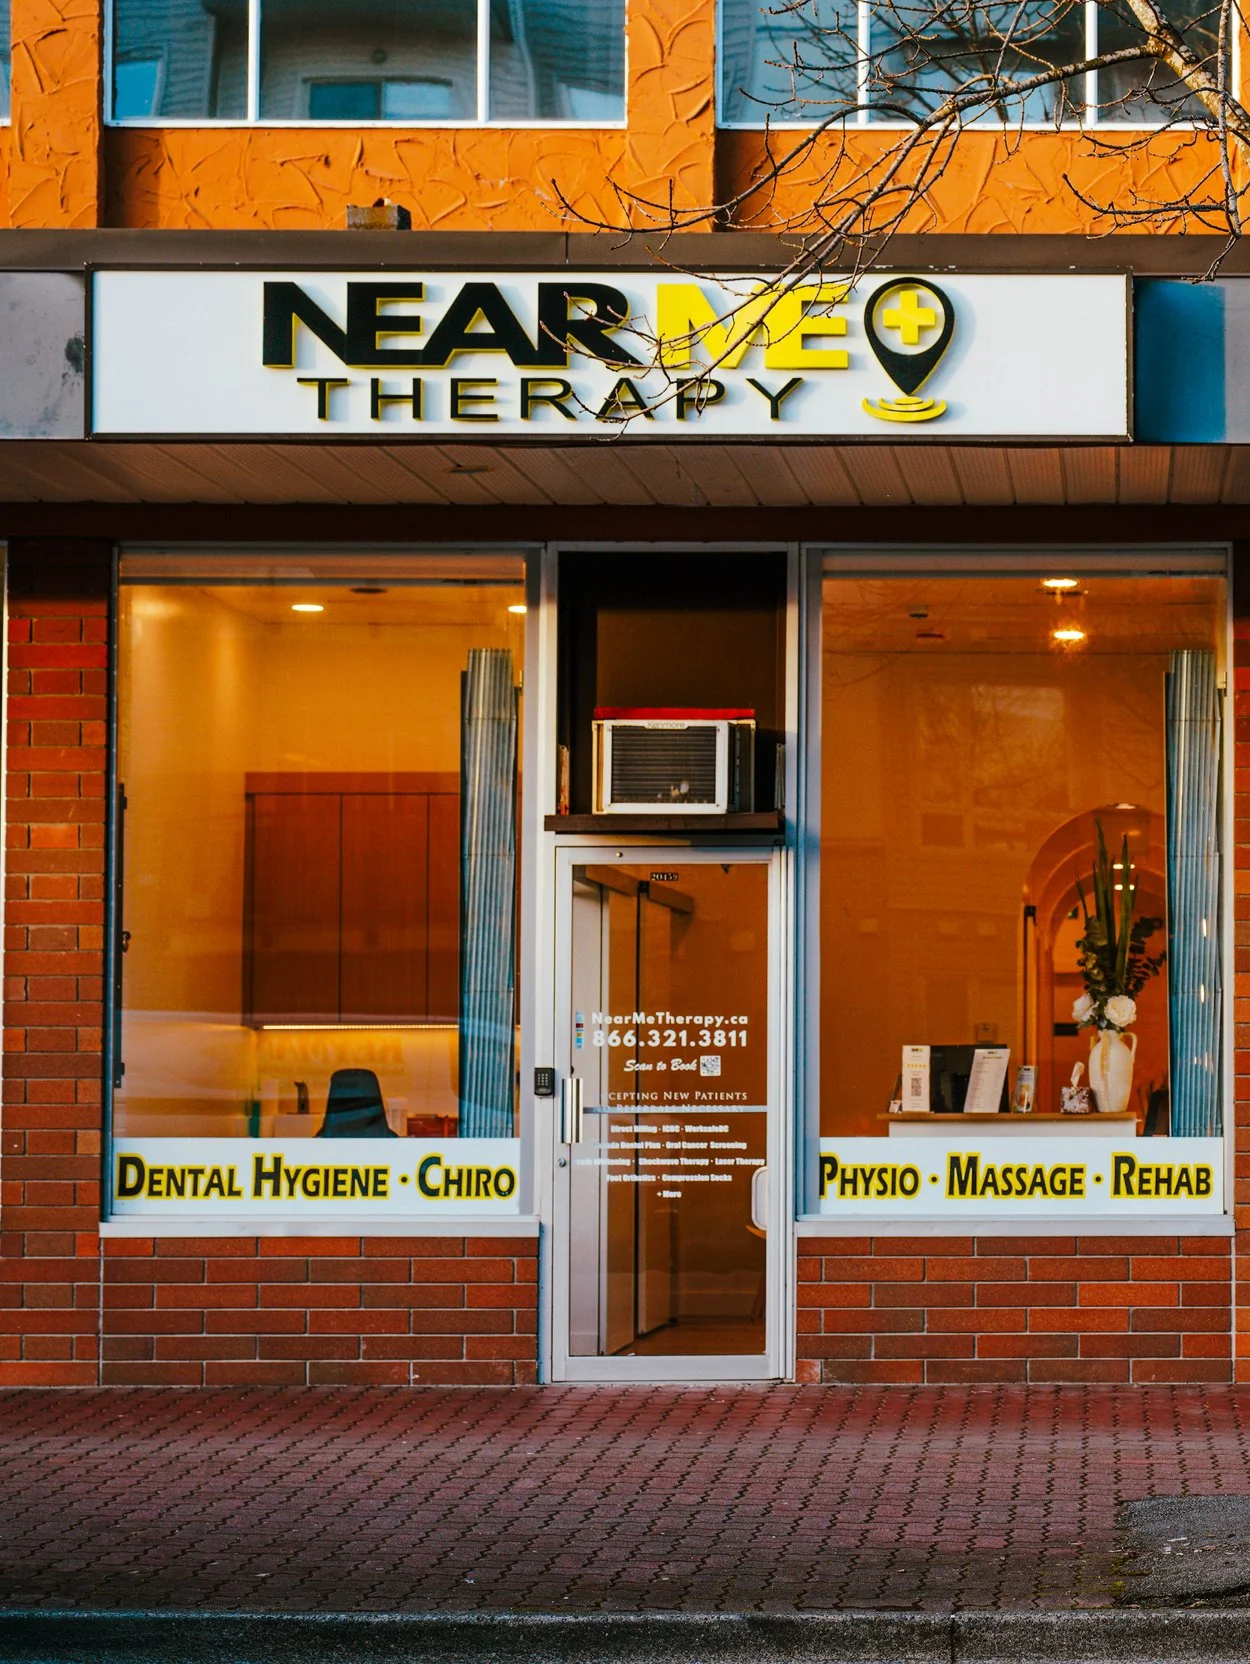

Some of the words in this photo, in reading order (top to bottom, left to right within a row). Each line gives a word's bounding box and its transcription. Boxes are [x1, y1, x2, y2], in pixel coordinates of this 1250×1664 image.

[296, 377, 802, 423] THERAPY
[591, 1012, 748, 1027] NearMeTherapy.ca
[592, 1030, 747, 1047] 866.321.3811
[624, 1059, 653, 1072] Scan
[656, 1061, 667, 1071] to
[671, 1058, 698, 1071] Book
[663, 1091, 690, 1100] NEW
[695, 1091, 748, 1100] PATIENTS
[116, 1155, 243, 1199] DENTAL
[252, 1155, 389, 1199] HYGIENE
[419, 1155, 515, 1199] CHIRO
[819, 1154, 920, 1198] PHYSIO
[947, 1154, 1085, 1198] MASSAGE
[1112, 1154, 1212, 1198] REHAB
